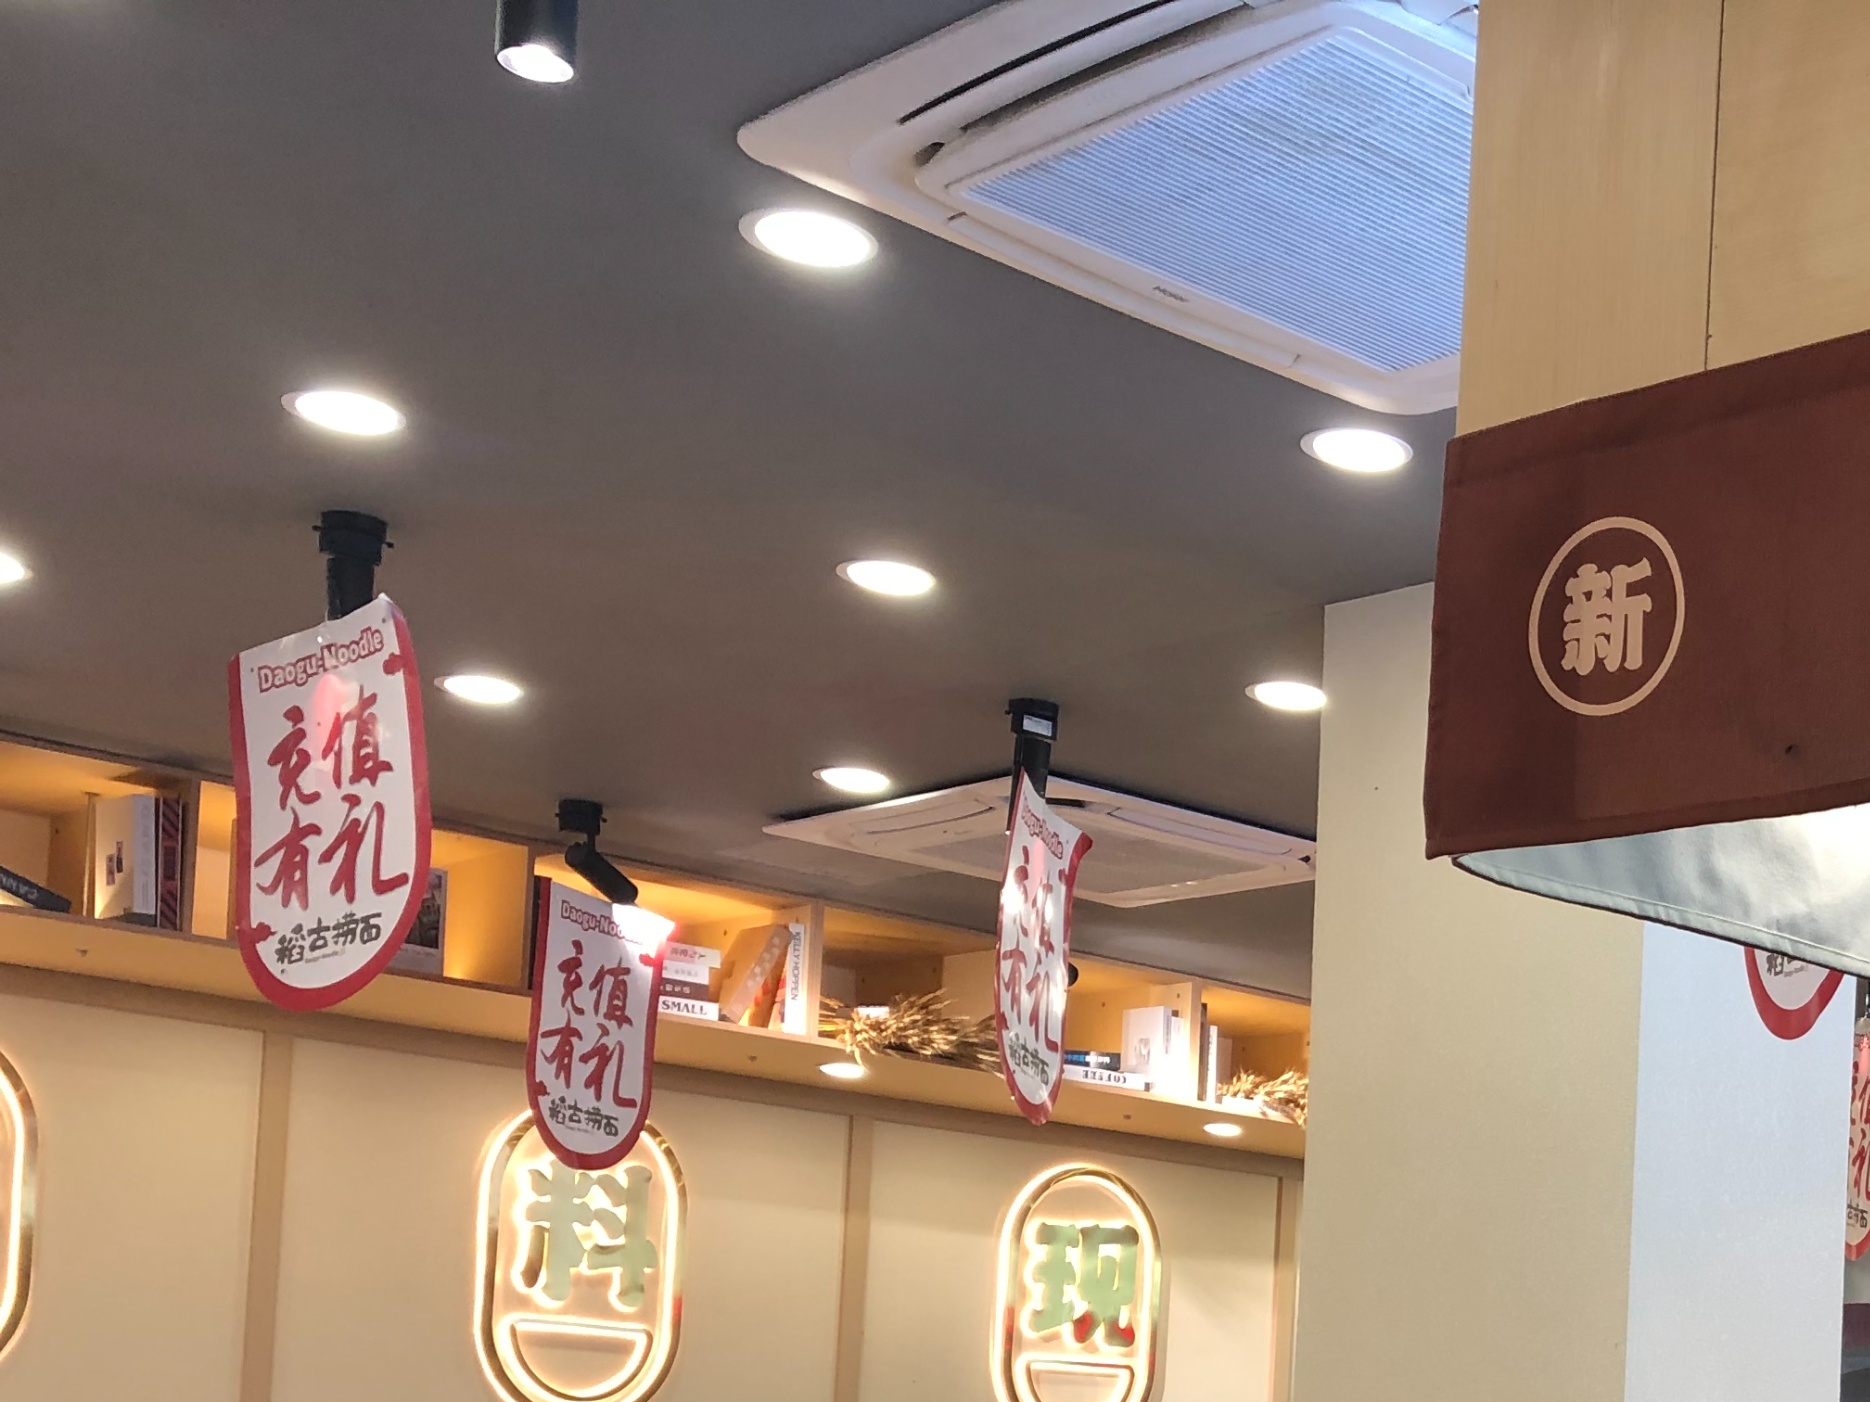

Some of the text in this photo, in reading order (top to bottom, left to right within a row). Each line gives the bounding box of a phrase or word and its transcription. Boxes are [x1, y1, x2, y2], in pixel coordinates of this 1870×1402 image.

[257, 627, 385, 693] Daogu-Noodle
[1561, 558, 1653, 676] 新
[267, 685, 394, 811] 充值
[254, 794, 410, 911] 有礼
[275, 911, 383, 966] 稻古捞面
[557, 939, 634, 1029] 充值
[540, 1006, 638, 1109] 有礼
[661, 999, 708, 1016] SMALL
[548, 1095, 619, 1138] 稻古捞面
[521, 1165, 657, 1307] 料
[1027, 1221, 1141, 1349] 现
